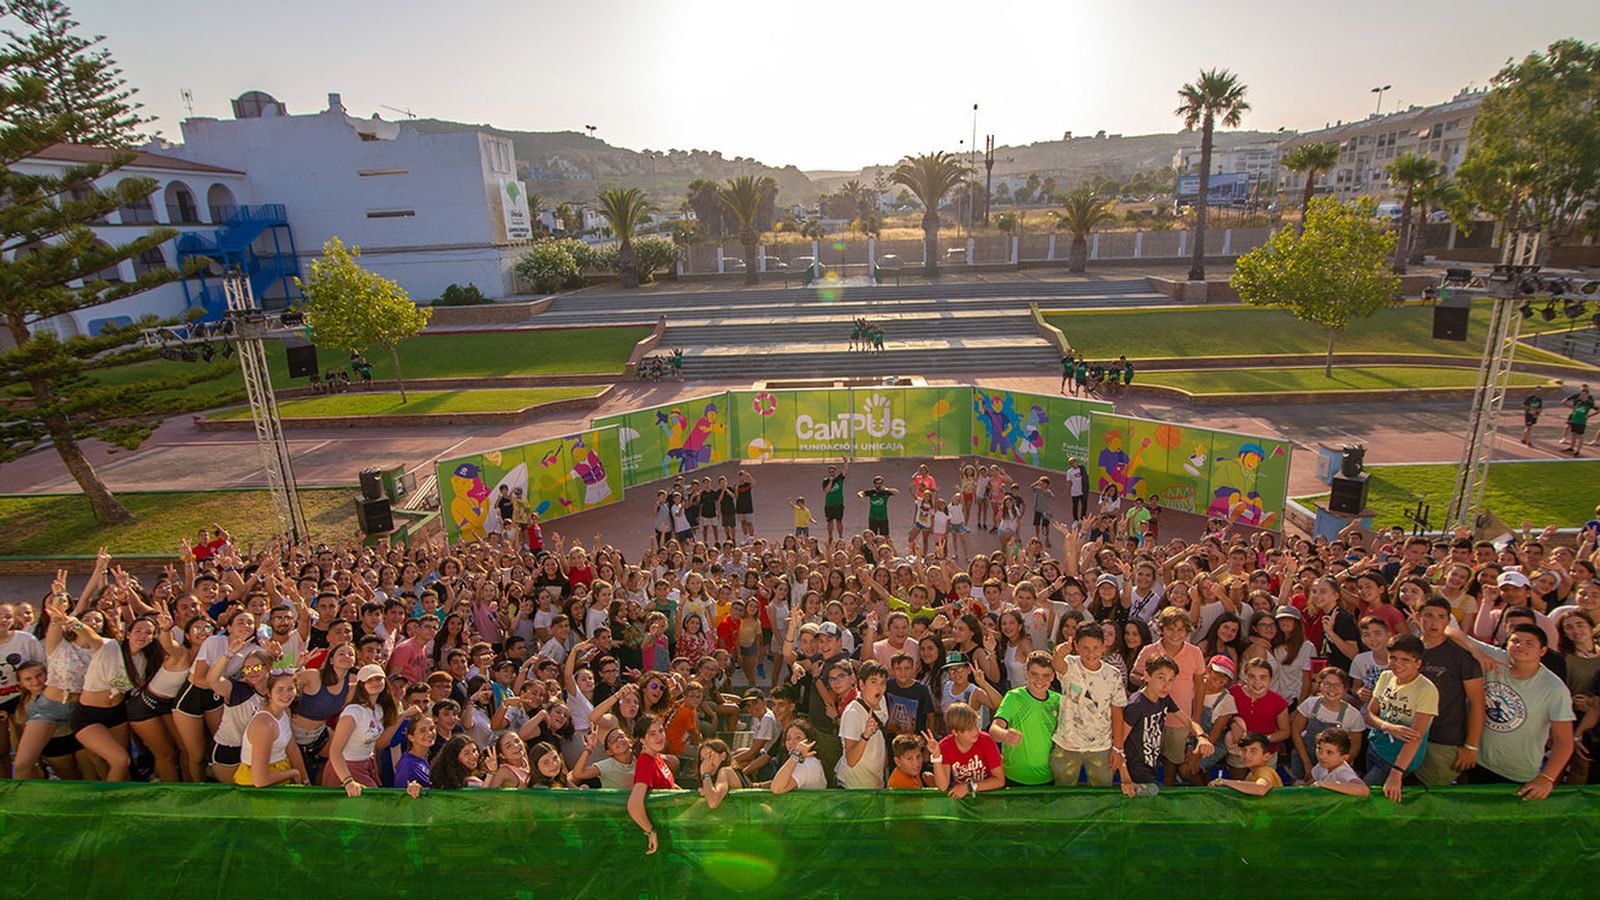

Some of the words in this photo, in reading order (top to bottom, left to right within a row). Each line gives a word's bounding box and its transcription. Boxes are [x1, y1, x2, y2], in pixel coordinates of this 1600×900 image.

[799, 442, 858, 451] FUNDACIÓN
[861, 442, 904, 452] UNICAJA
[952, 754, 983, 777] South
